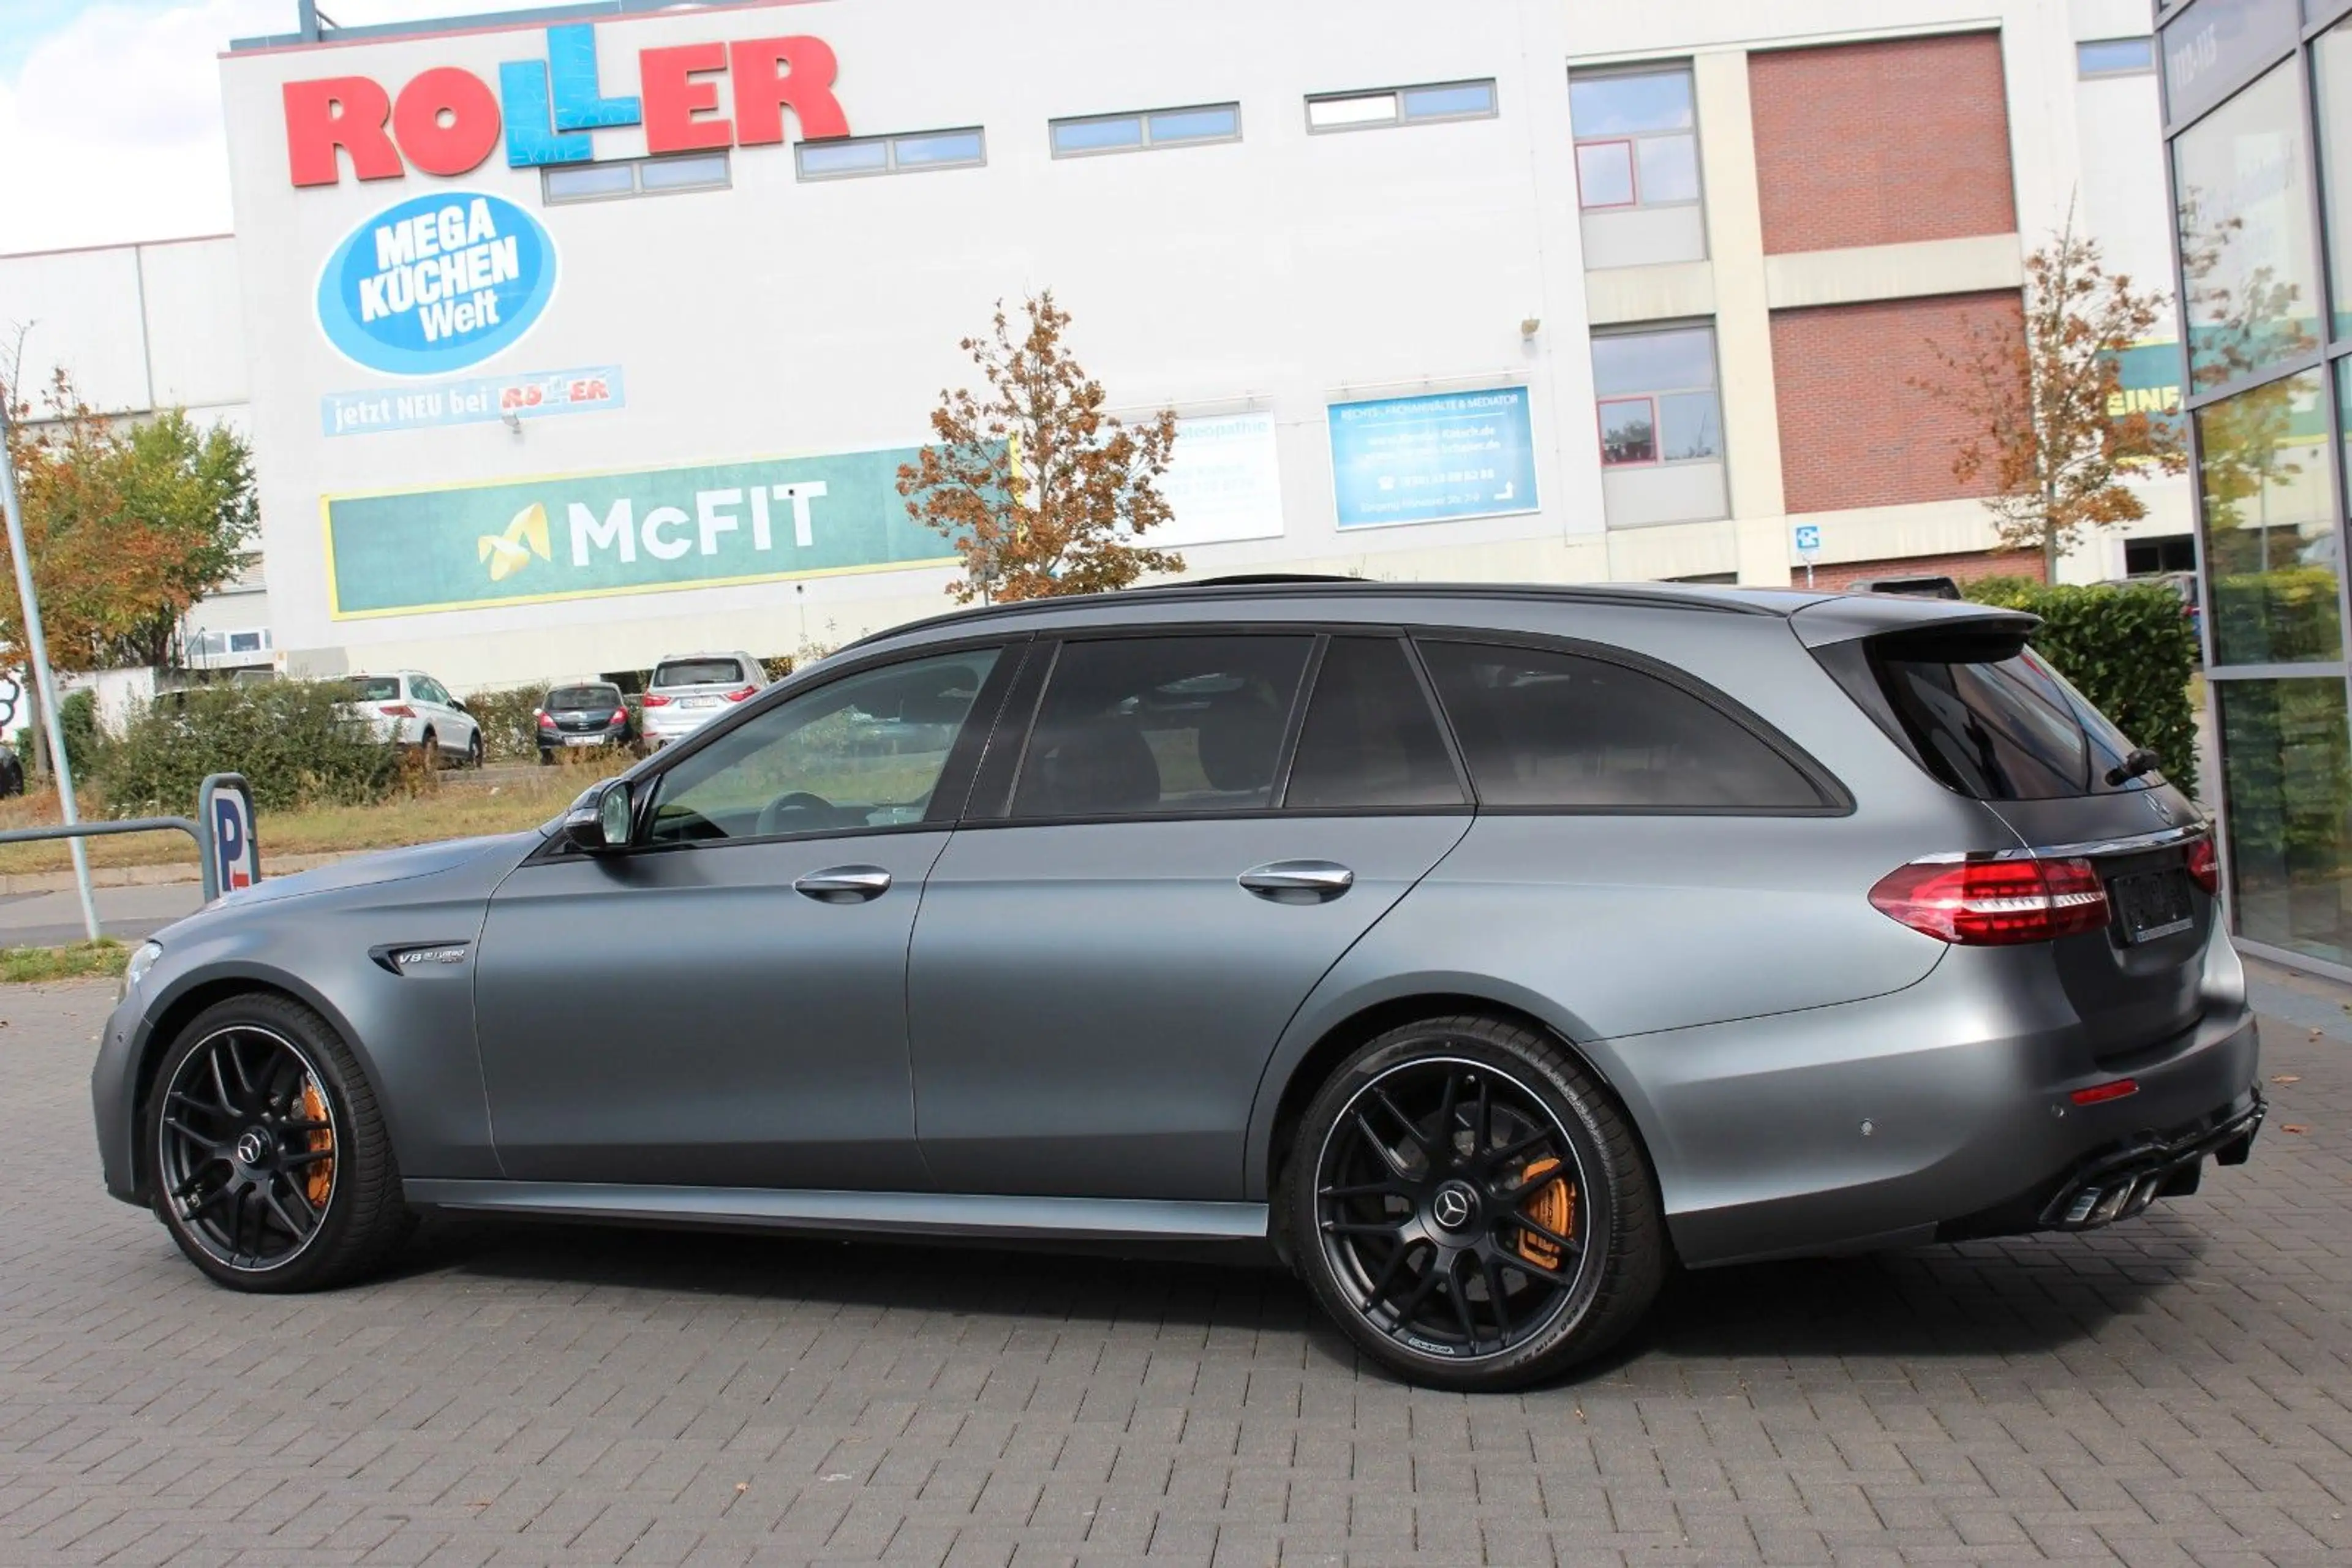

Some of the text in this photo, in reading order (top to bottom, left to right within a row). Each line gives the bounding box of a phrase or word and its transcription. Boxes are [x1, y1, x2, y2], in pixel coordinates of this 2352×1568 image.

[283, 23, 850, 187] ROLLER
[375, 197, 496, 271] MEGA
[359, 235, 519, 322] KÜCHEN
[419, 288, 500, 342] Welt
[334, 375, 610, 432] jetzt NEU bei ROLLER
[1467, 394, 1518, 409] MEDIATOR
[568, 481, 827, 567] McFIT
[216, 798, 243, 891] P
[399, 953, 422, 964] V8
